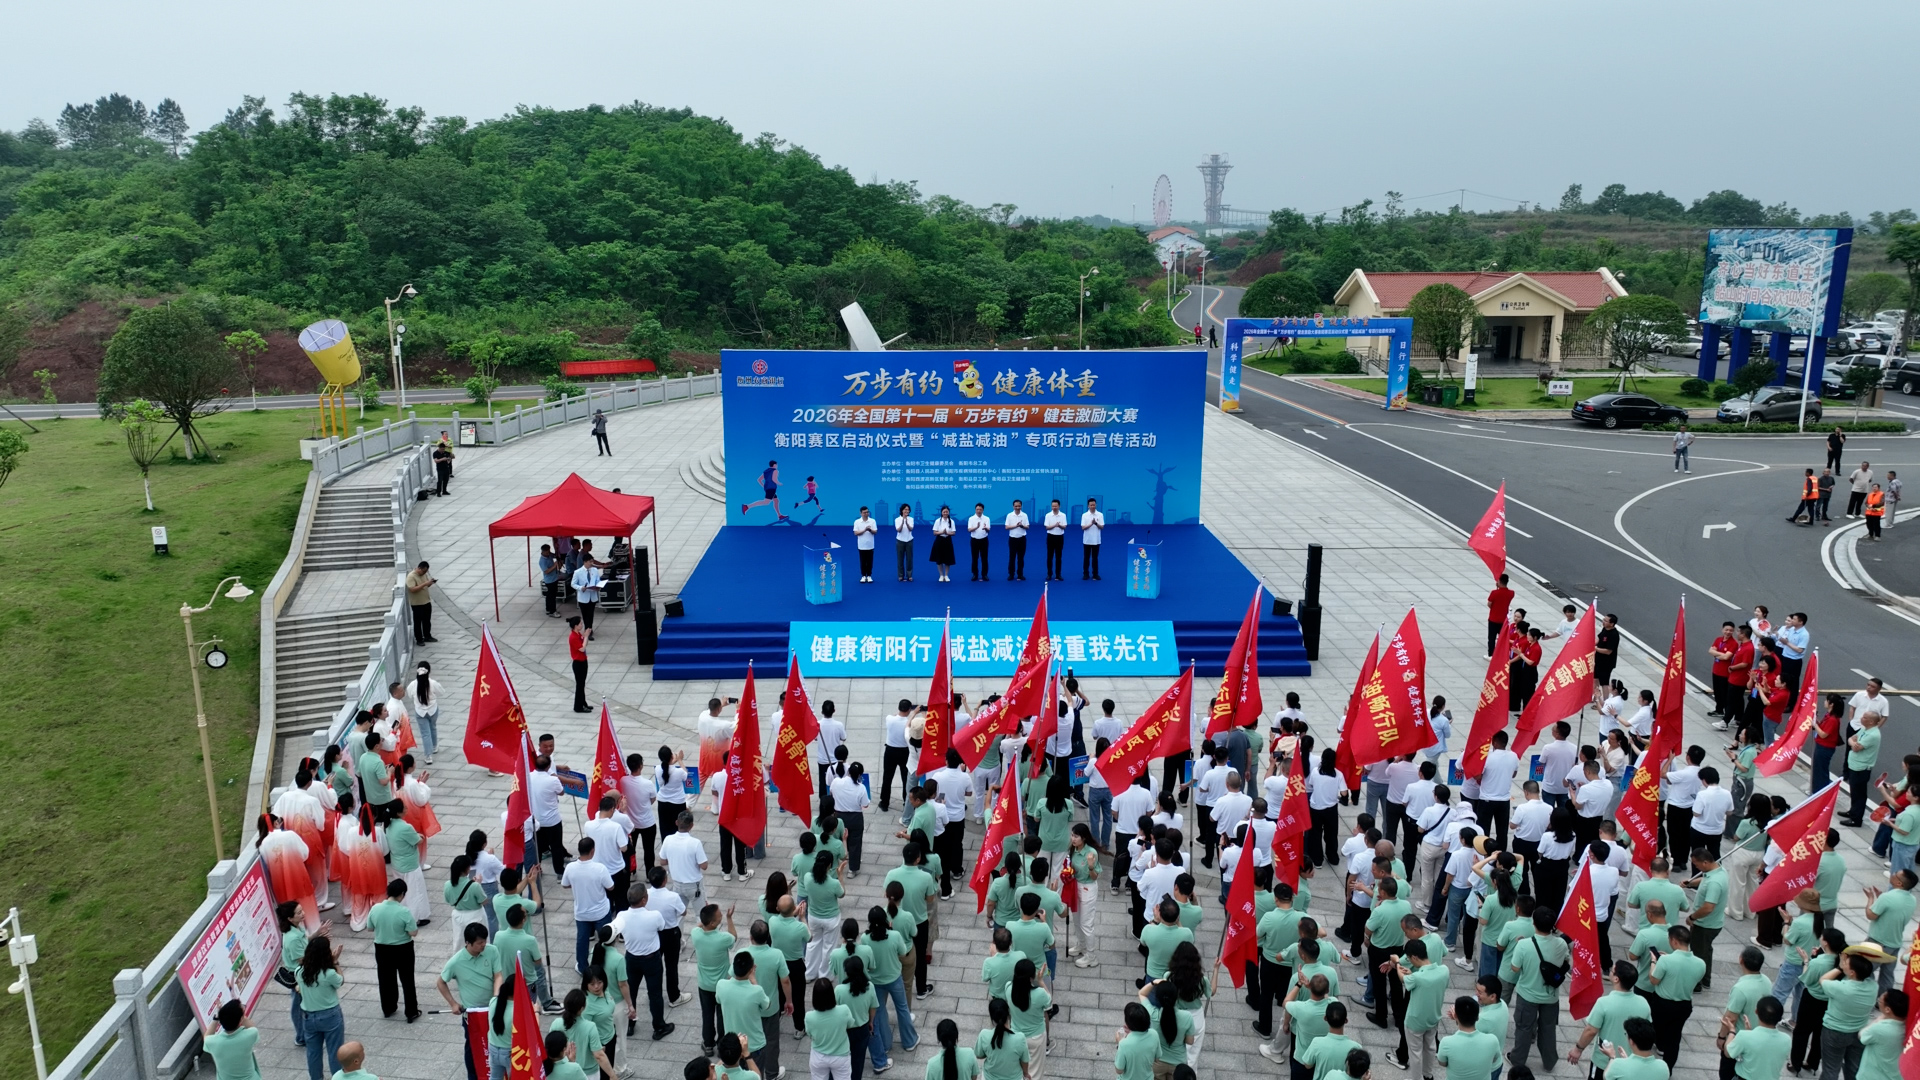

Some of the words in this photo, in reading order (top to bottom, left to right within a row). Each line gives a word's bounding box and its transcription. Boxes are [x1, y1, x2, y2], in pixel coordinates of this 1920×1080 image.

[1718, 262, 1815, 282] 齐心当好东道主
[1714, 285, 1814, 308] 船山时间谷欢迎您
[1271, 315, 1308, 327] 万步有约
[1228, 342, 1239, 386] 科学健走
[1397, 341, 1407, 384] 日行万步
[839, 367, 943, 401] 万步有约
[991, 367, 1099, 399] 健康体重
[792, 407, 1139, 425] 2026年全国第十一届“万步有约”健走激励大赛
[774, 432, 1157, 449] 衡阳赛区启动仪式暨“减盐减油”专项行动宣传活动
[810, 634, 932, 664] 健康衡阳行
[949, 634, 1160, 664] 减盐减减重我先行
[1392, 633, 1410, 666] 万步有约
[1407, 685, 1424, 728] 健康体重
